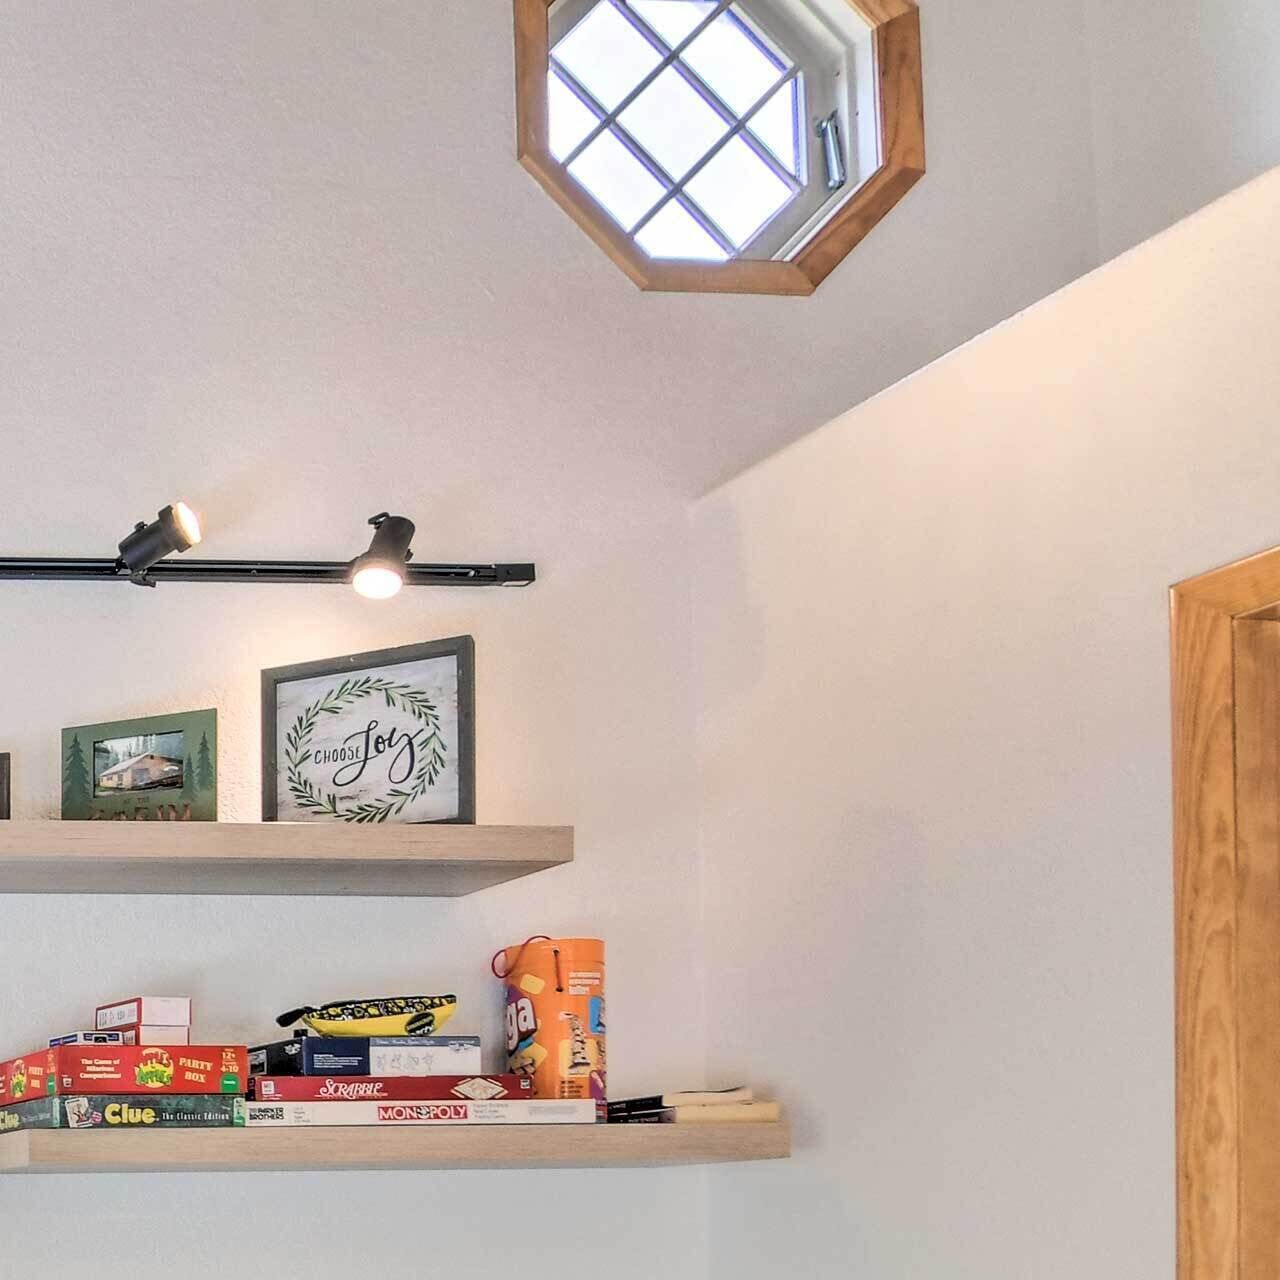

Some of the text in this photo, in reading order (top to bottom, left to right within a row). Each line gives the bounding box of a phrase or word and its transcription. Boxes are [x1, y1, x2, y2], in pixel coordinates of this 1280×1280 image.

[314, 719, 425, 787] CHOOSE Joy
[178, 1057, 214, 1073] PARTY
[184, 1071, 207, 1083] BOX
[104, 1103, 156, 1125] Clue
[162, 1112, 229, 1121] The Classic Edition
[249, 1113, 285, 1121] BROTHERS
[378, 1105, 467, 1120] MONOPOLY
